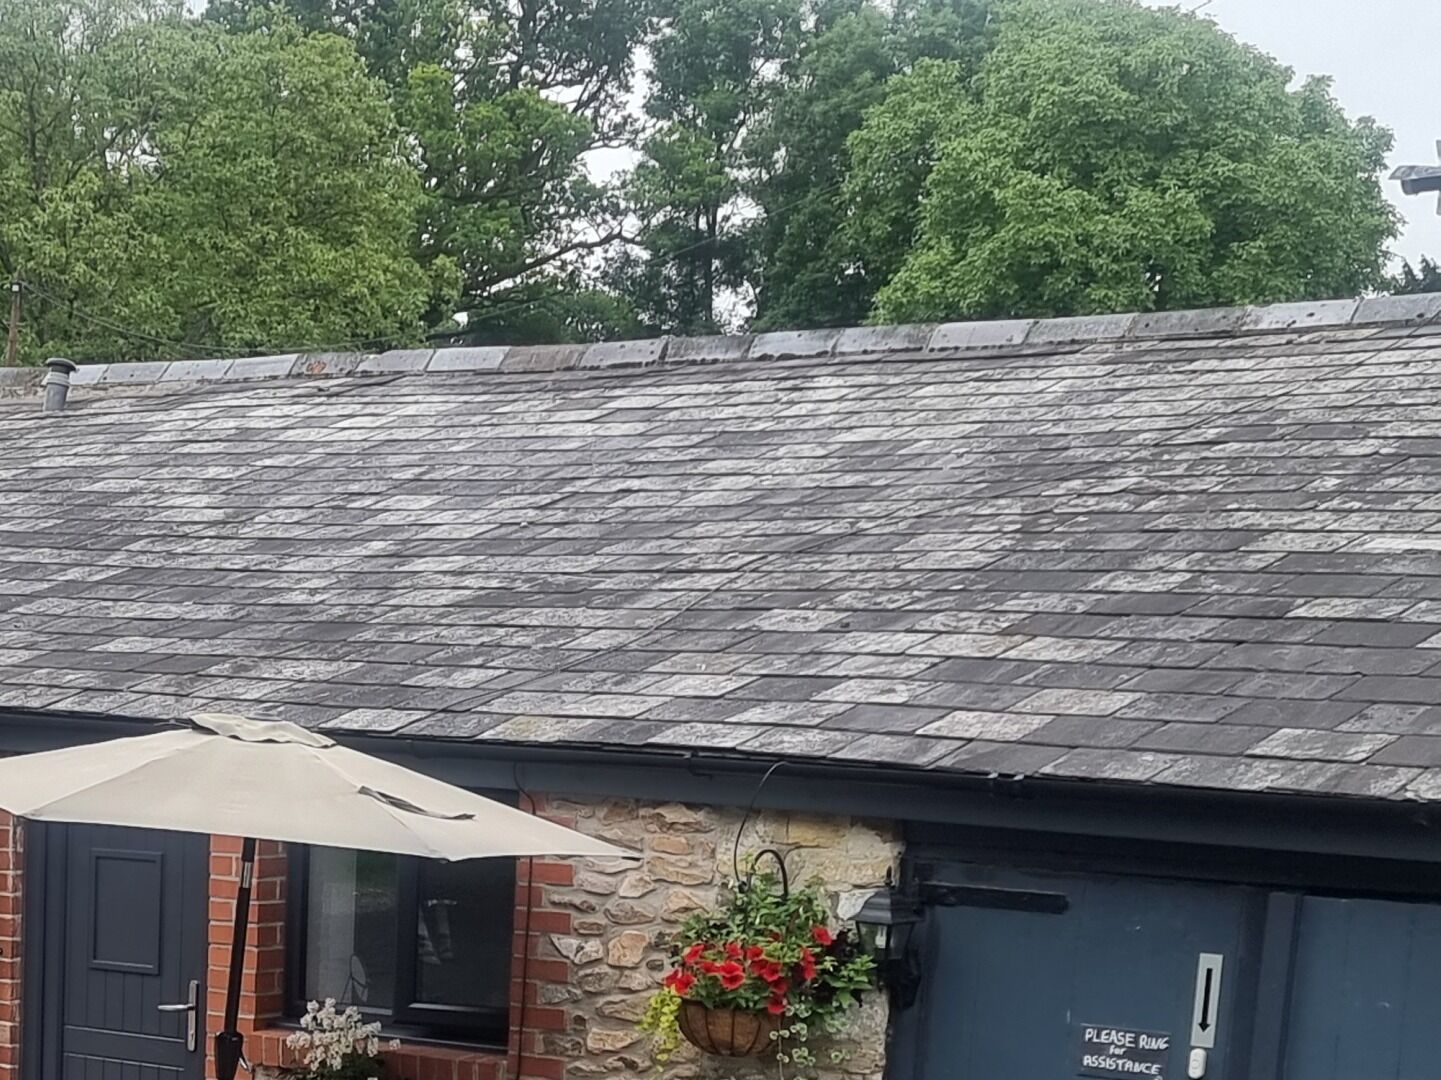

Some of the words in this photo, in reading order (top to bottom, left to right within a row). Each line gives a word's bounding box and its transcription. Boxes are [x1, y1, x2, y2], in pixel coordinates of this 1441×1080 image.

[1085, 1028, 1136, 1047] PLEASE
[1139, 1034, 1169, 1050] RING
[1083, 1055, 1162, 1075] ASSISTANCE
